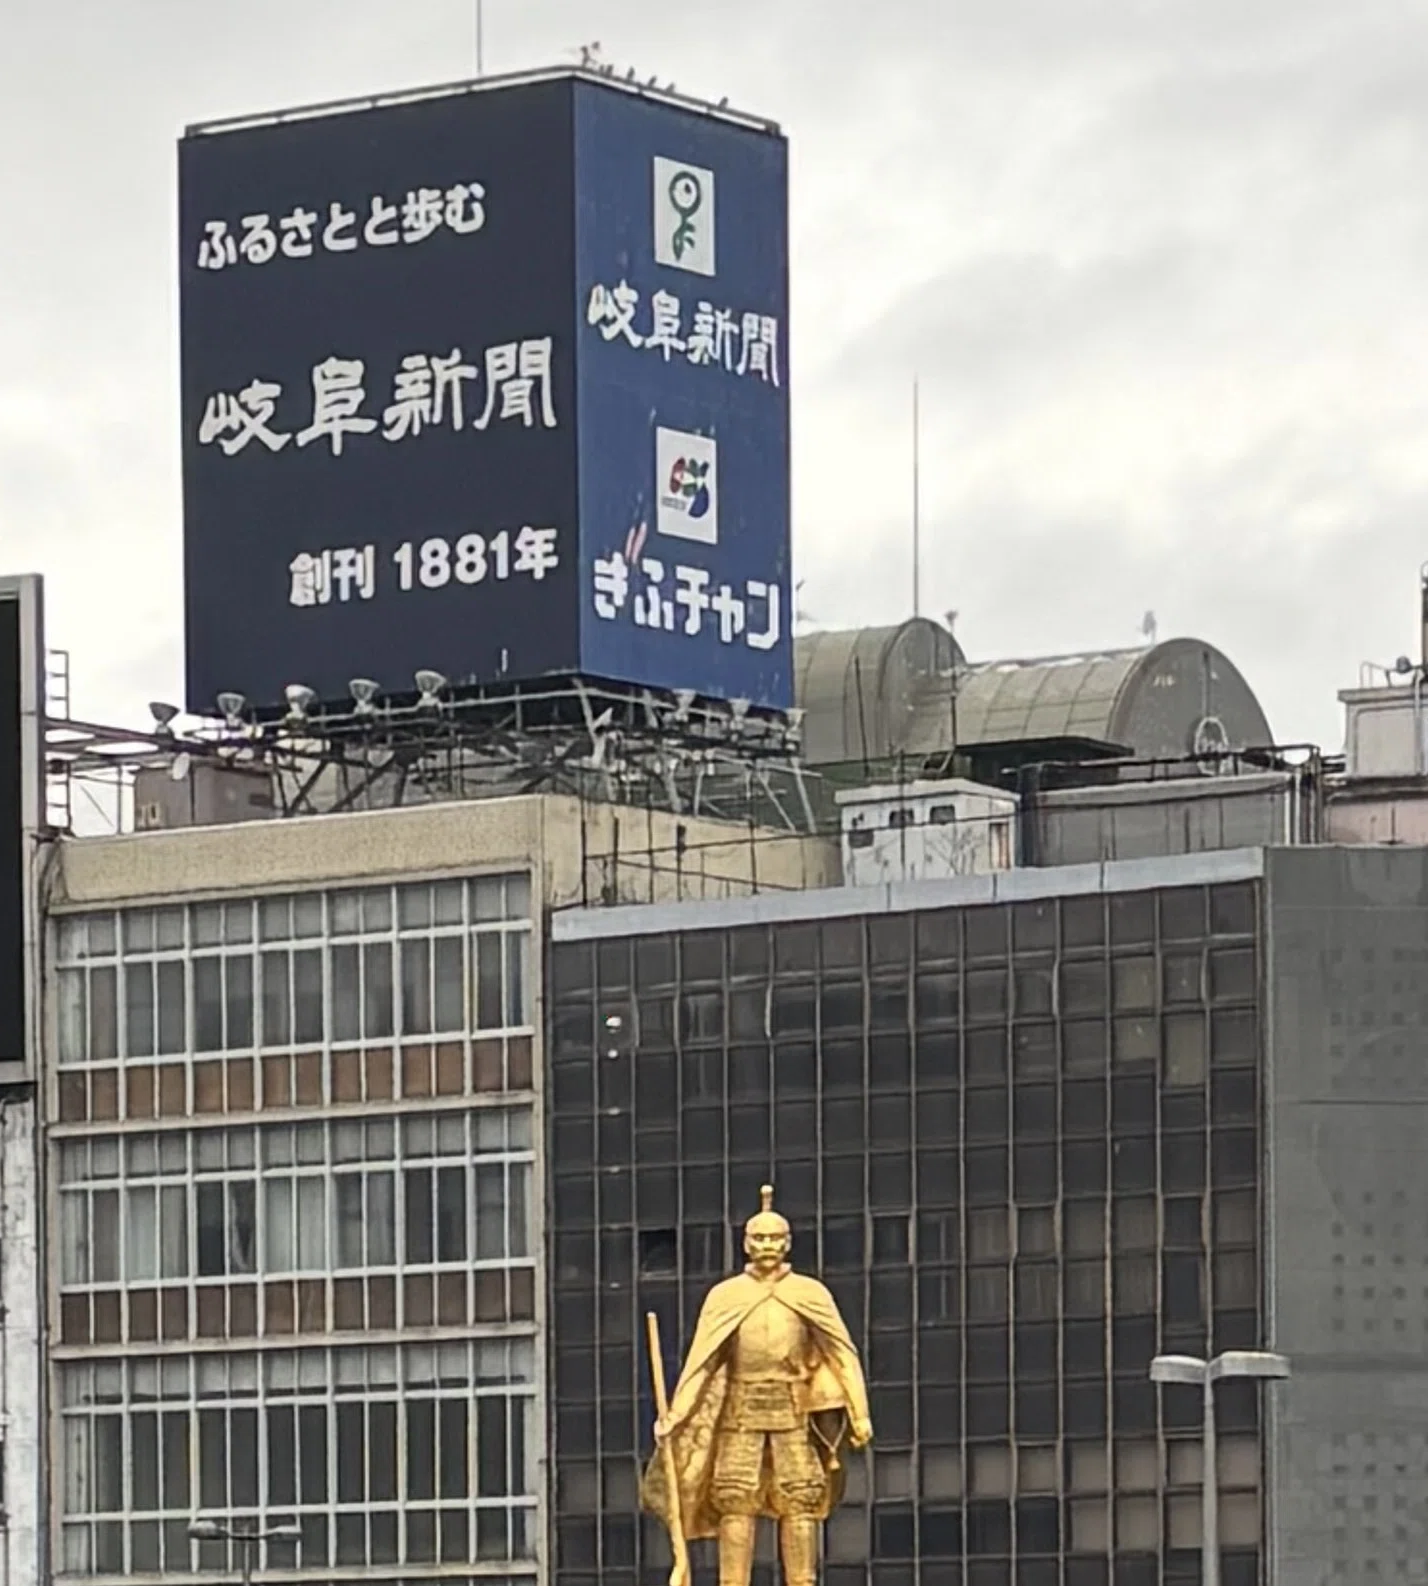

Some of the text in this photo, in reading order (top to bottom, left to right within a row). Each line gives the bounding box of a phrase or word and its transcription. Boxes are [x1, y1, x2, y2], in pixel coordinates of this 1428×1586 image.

[197, 183, 485, 270] ふるさとと歩む
[587, 279, 780, 387] 岐阜新聞
[199, 336, 558, 456] 岐阜新聞
[289, 525, 559, 607] 創刊 1881年
[593, 522, 780, 650] ぎふチャン
